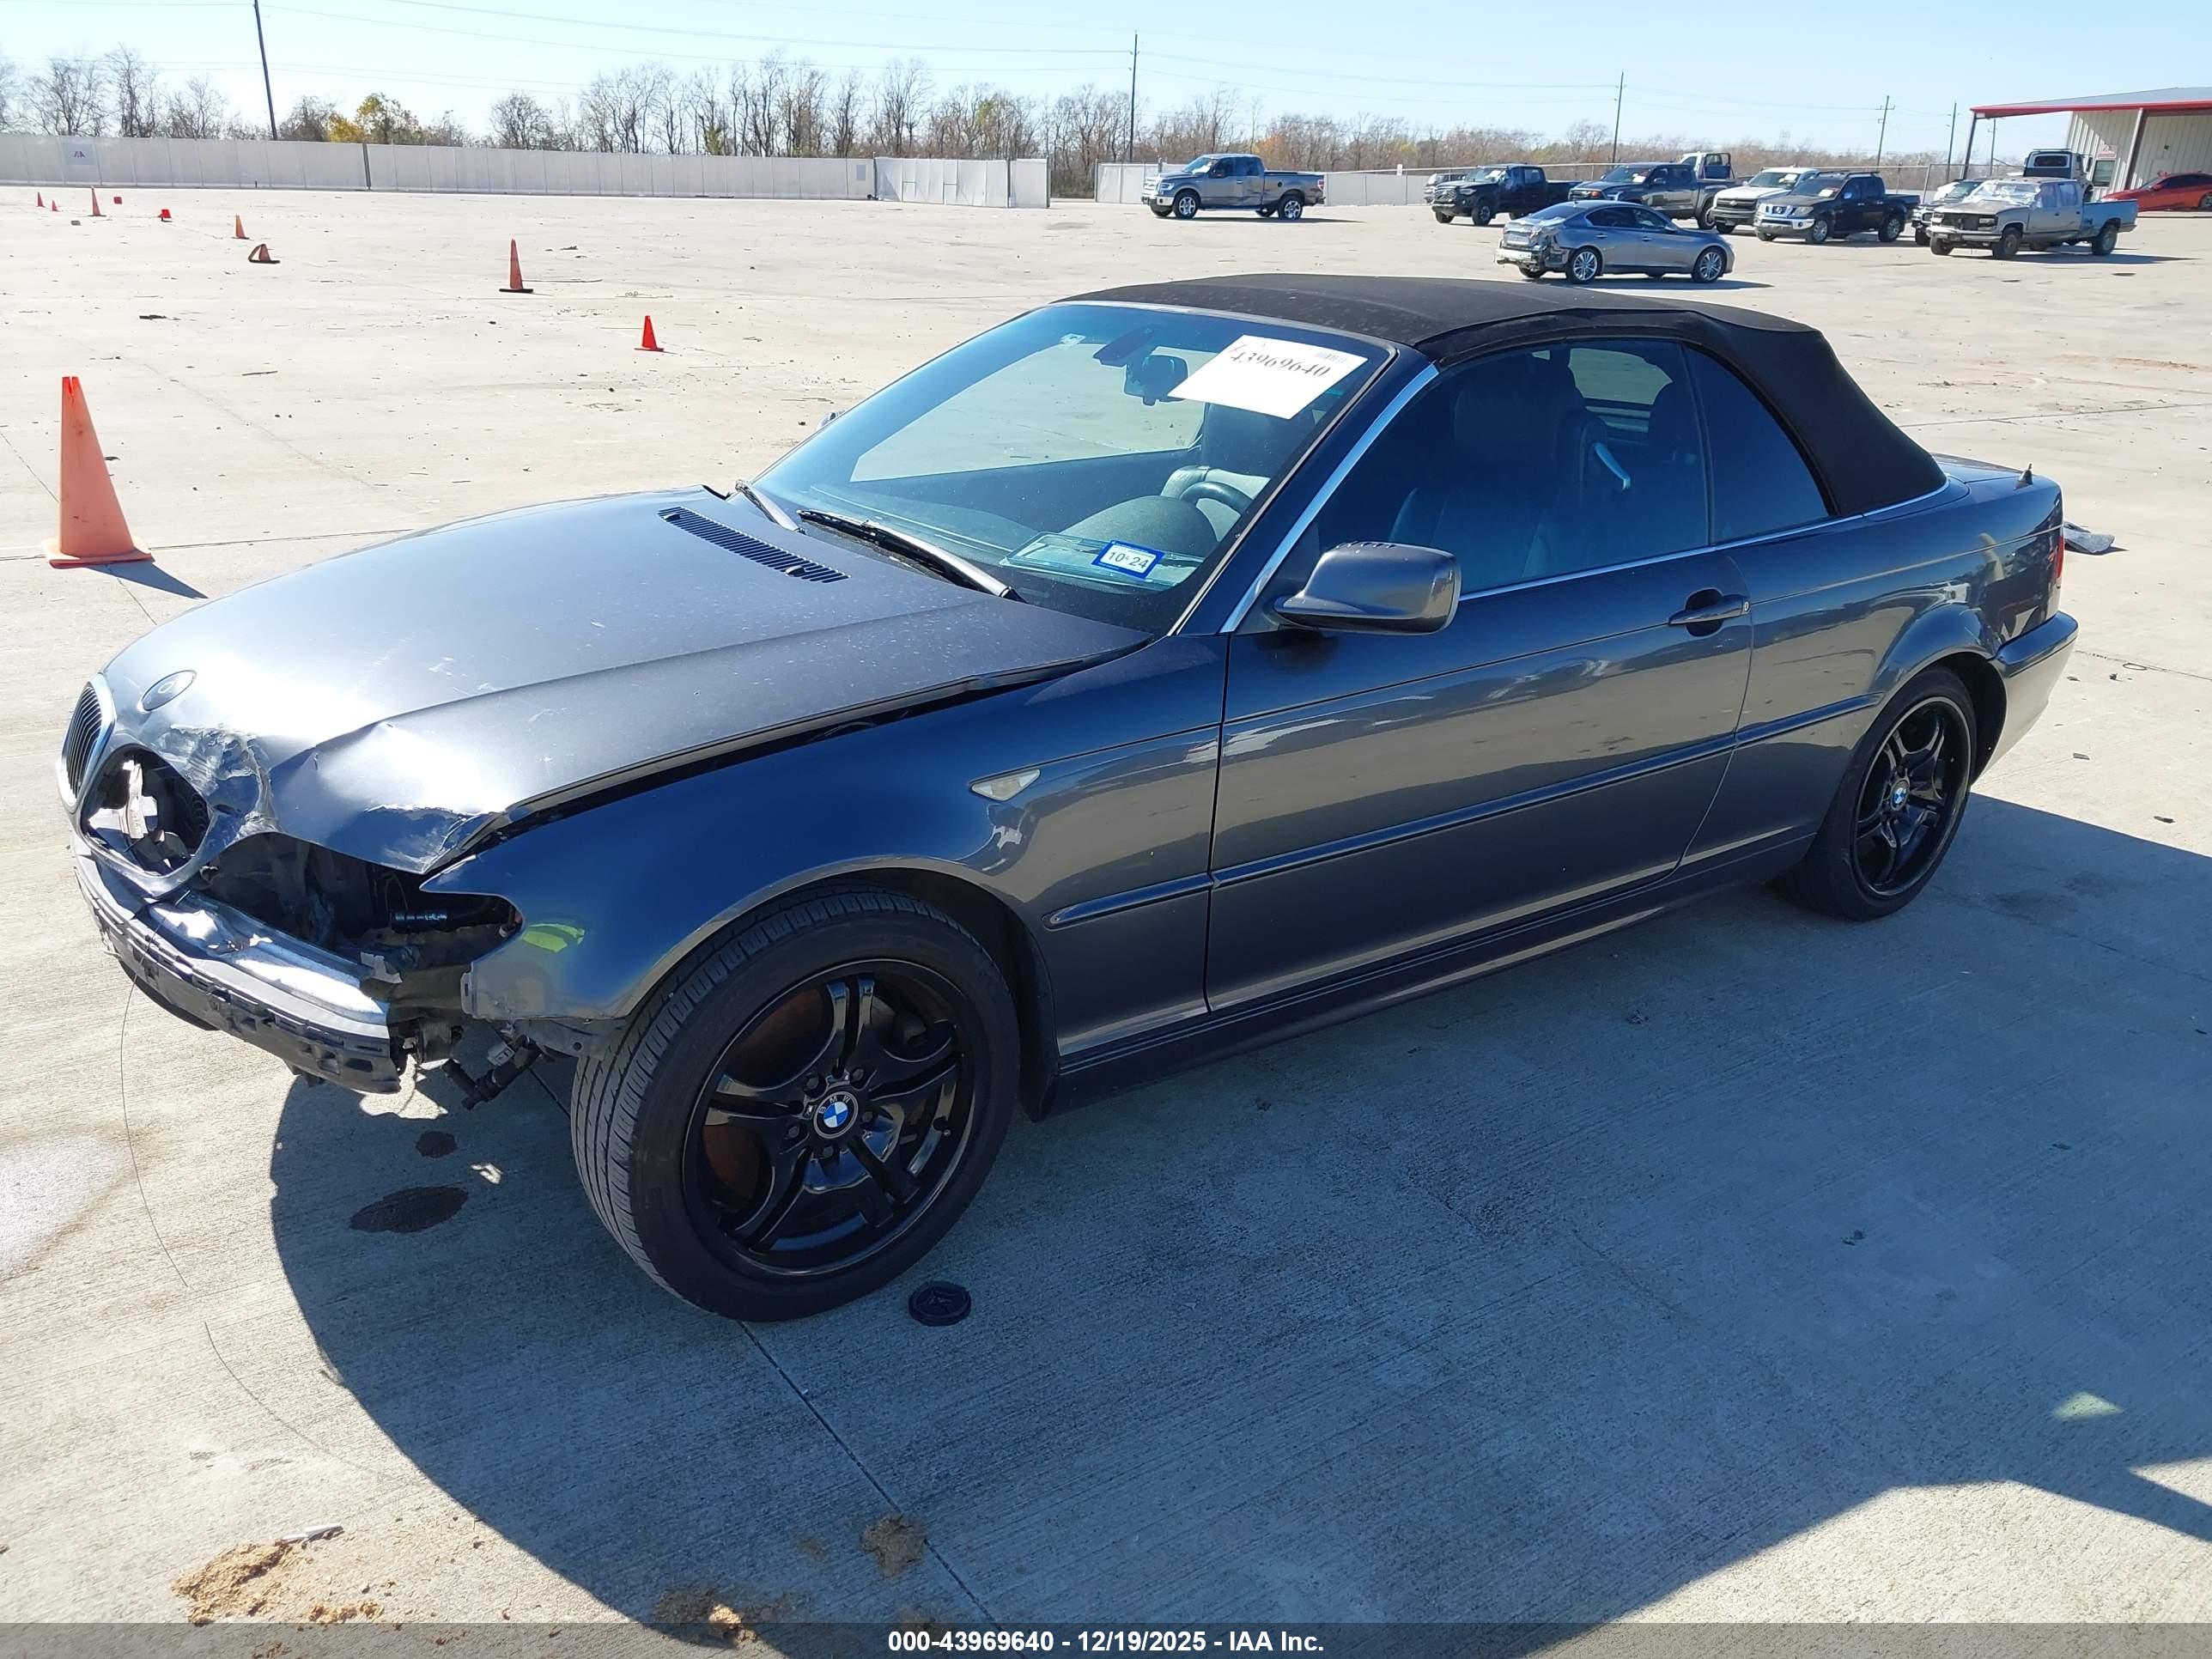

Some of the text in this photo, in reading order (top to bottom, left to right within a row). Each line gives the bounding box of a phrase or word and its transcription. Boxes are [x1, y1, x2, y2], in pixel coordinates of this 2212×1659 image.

[1230, 351, 1332, 378] 43969640
[1109, 551, 1126, 562] 10
[1128, 556, 1149, 568] 24
